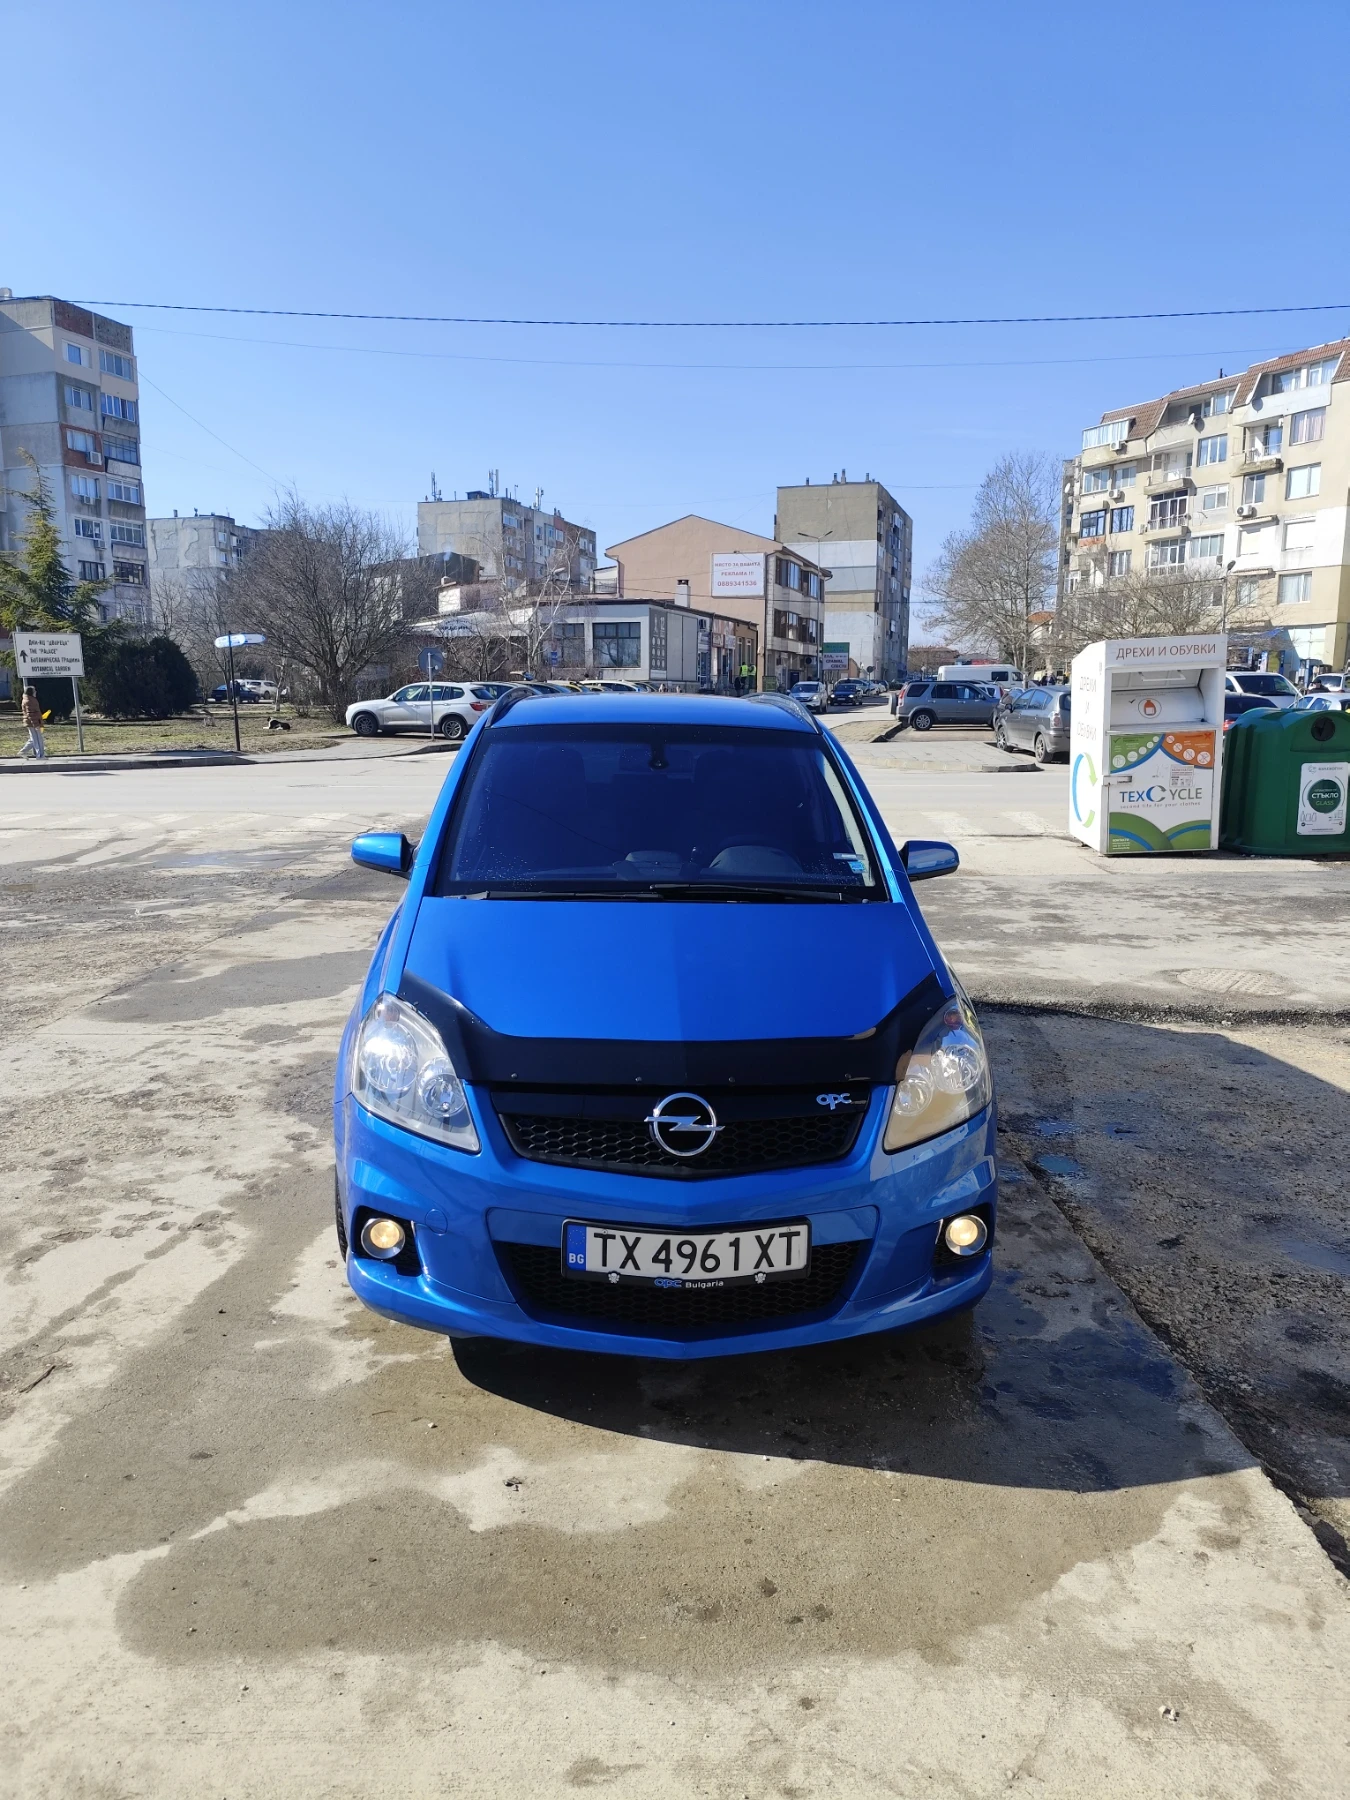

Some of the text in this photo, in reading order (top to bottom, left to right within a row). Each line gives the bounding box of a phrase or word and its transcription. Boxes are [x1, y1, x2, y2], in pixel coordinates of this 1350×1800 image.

[1116, 643, 1216, 660] ДРЕХИ И ОБУВКИ
[568, 1253, 585, 1265] BG
[651, 1237, 741, 1274] 4961
[685, 1279, 724, 1289] Bulgaria
